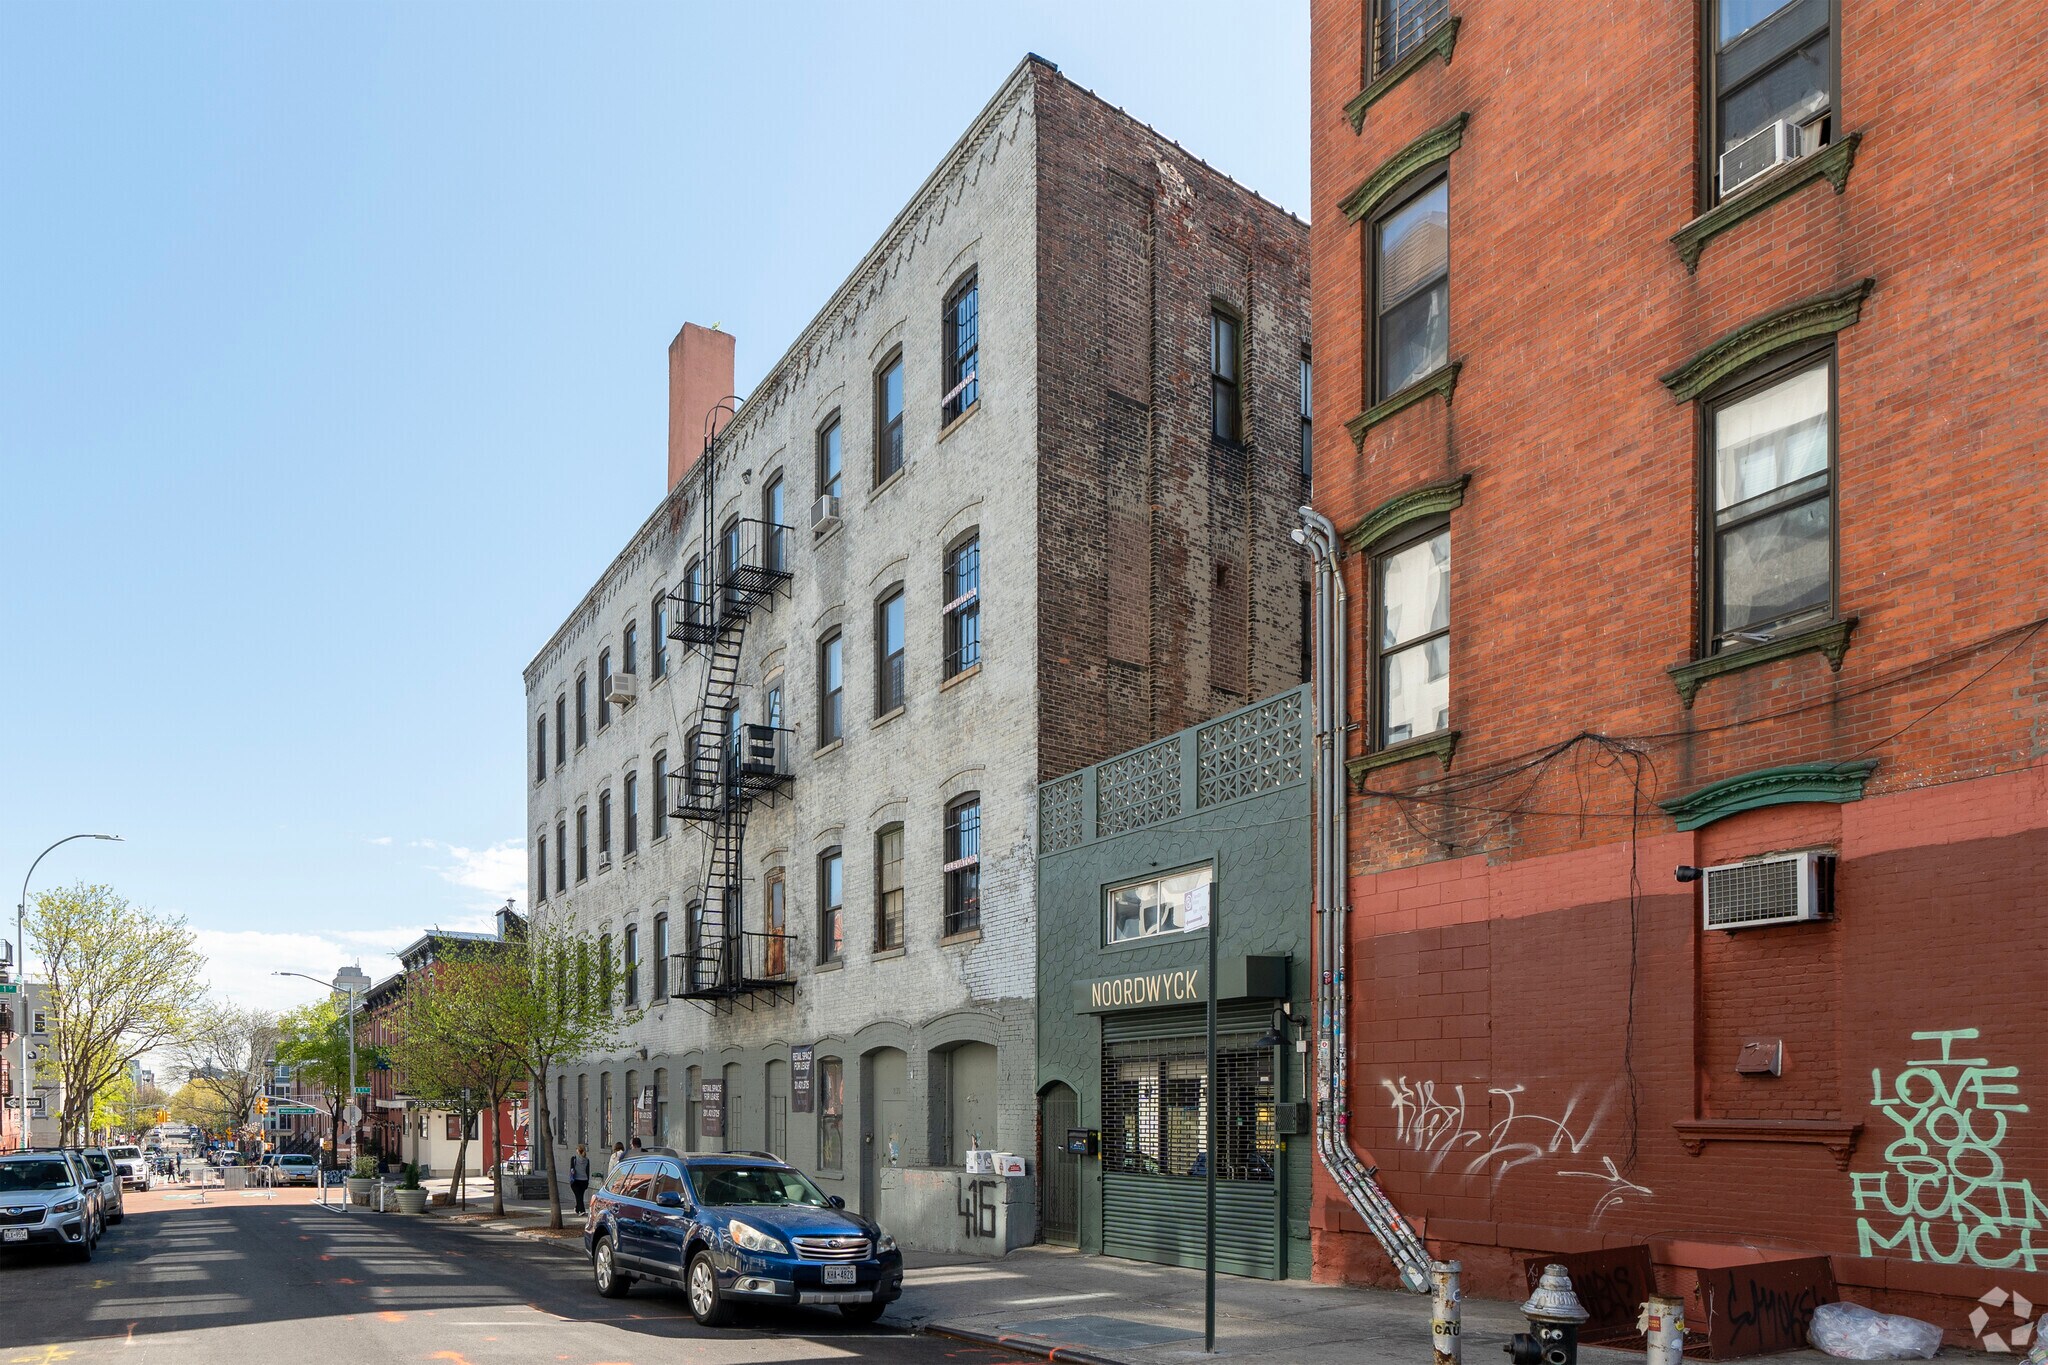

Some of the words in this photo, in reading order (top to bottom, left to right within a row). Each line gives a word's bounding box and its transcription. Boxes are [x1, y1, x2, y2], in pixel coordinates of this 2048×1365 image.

[945, 854, 977, 871] ELEVATOR
[1092, 969, 1198, 1007] NOORDWYCK
[801, 1061, 810, 1070] LEASE
[802, 1051, 812, 1060] SPACE
[1906, 1028, 1989, 1066] I
[702, 1084, 712, 1092] RETAIL
[712, 1084, 722, 1092] SPACE
[710, 1093, 720, 1101] LEASE
[1870, 1065, 2030, 1113] LOVE
[1882, 1105, 2007, 1148] YOU
[1884, 1137, 2004, 1183] SO
[957, 1176, 997, 1239] 416
